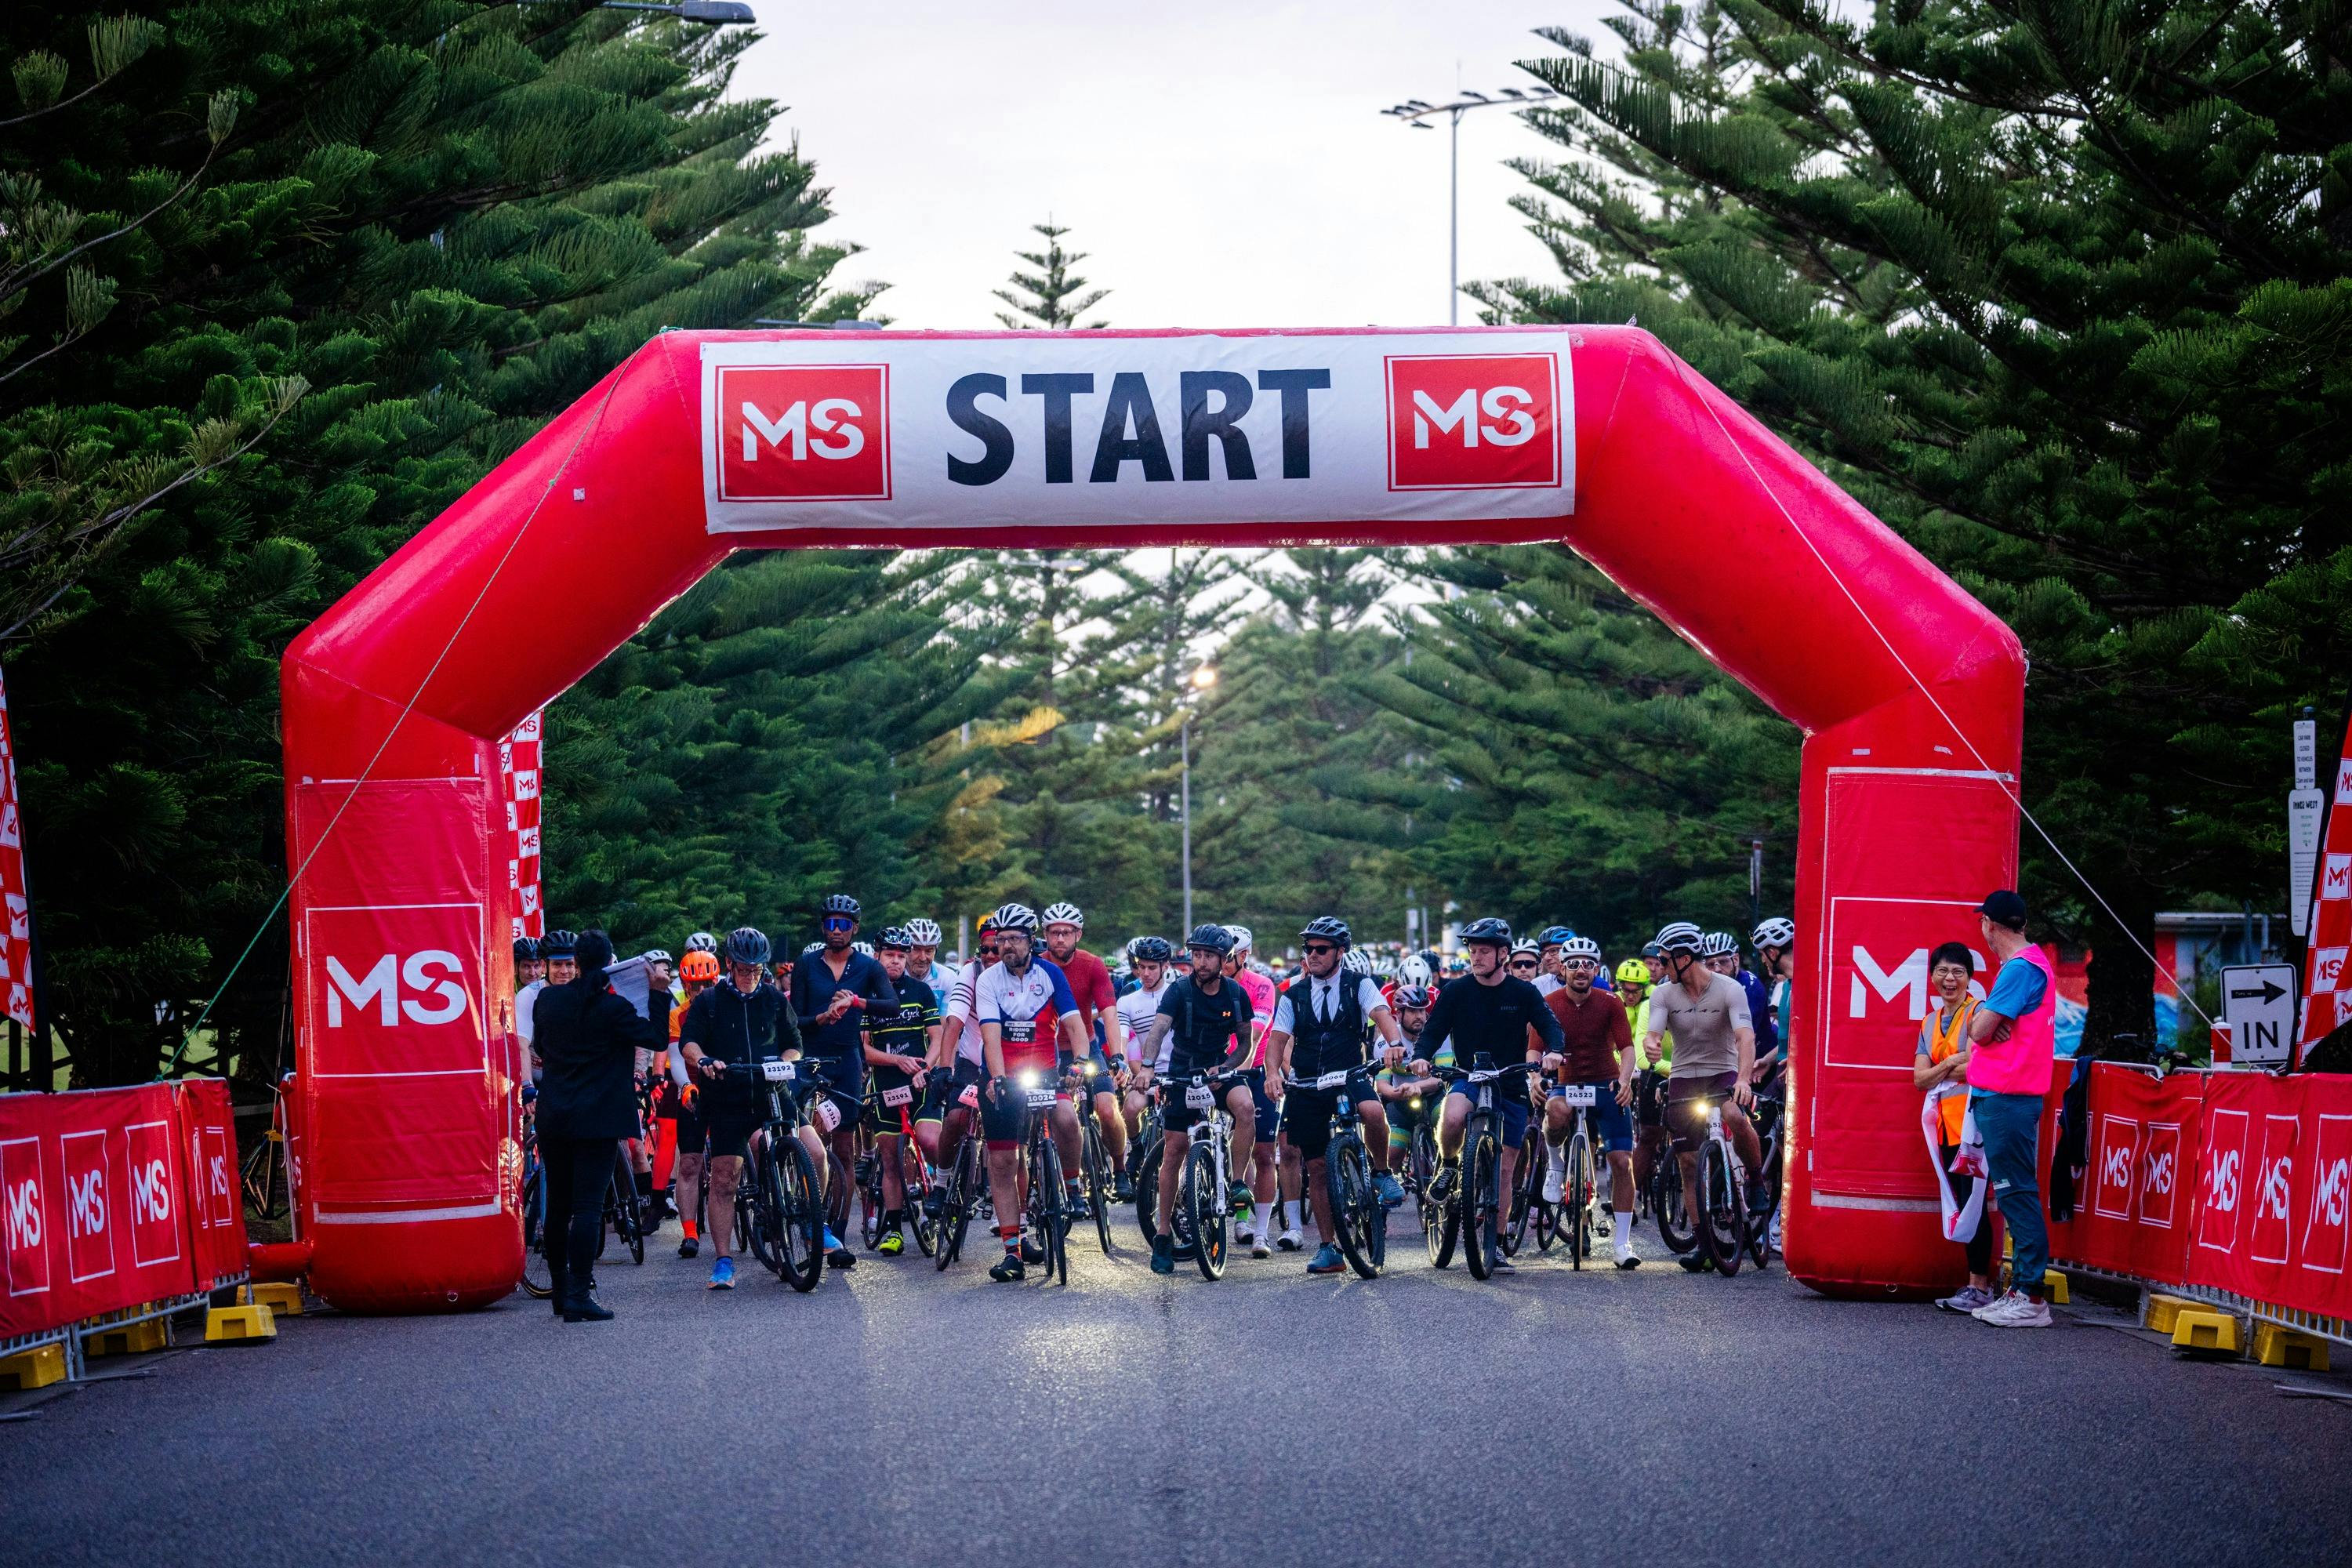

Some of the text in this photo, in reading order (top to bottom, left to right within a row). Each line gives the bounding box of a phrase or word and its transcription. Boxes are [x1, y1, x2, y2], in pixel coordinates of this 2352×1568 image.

[741, 398, 865, 462] MS
[945, 367, 1331, 486] START
[1413, 385, 1537, 449] MS
[519, 779, 535, 792] MS
[521, 834, 538, 850] MS
[326, 949, 467, 1029] MS
[2243, 1021, 2279, 1050] IN
[887, 1092, 909, 1102] 23191
[1187, 1093, 1211, 1102] 22015
[1319, 1074, 1345, 1083] 22060
[823, 1104, 837, 1126] 23314
[210, 1155, 227, 1196] MS
[2103, 1145, 2172, 1195] MS MS
[2206, 1149, 2348, 1227] MS MS MS
[8, 1178, 41, 1250] MS
[70, 1169, 105, 1239] MS
[133, 1159, 169, 1225] MS
